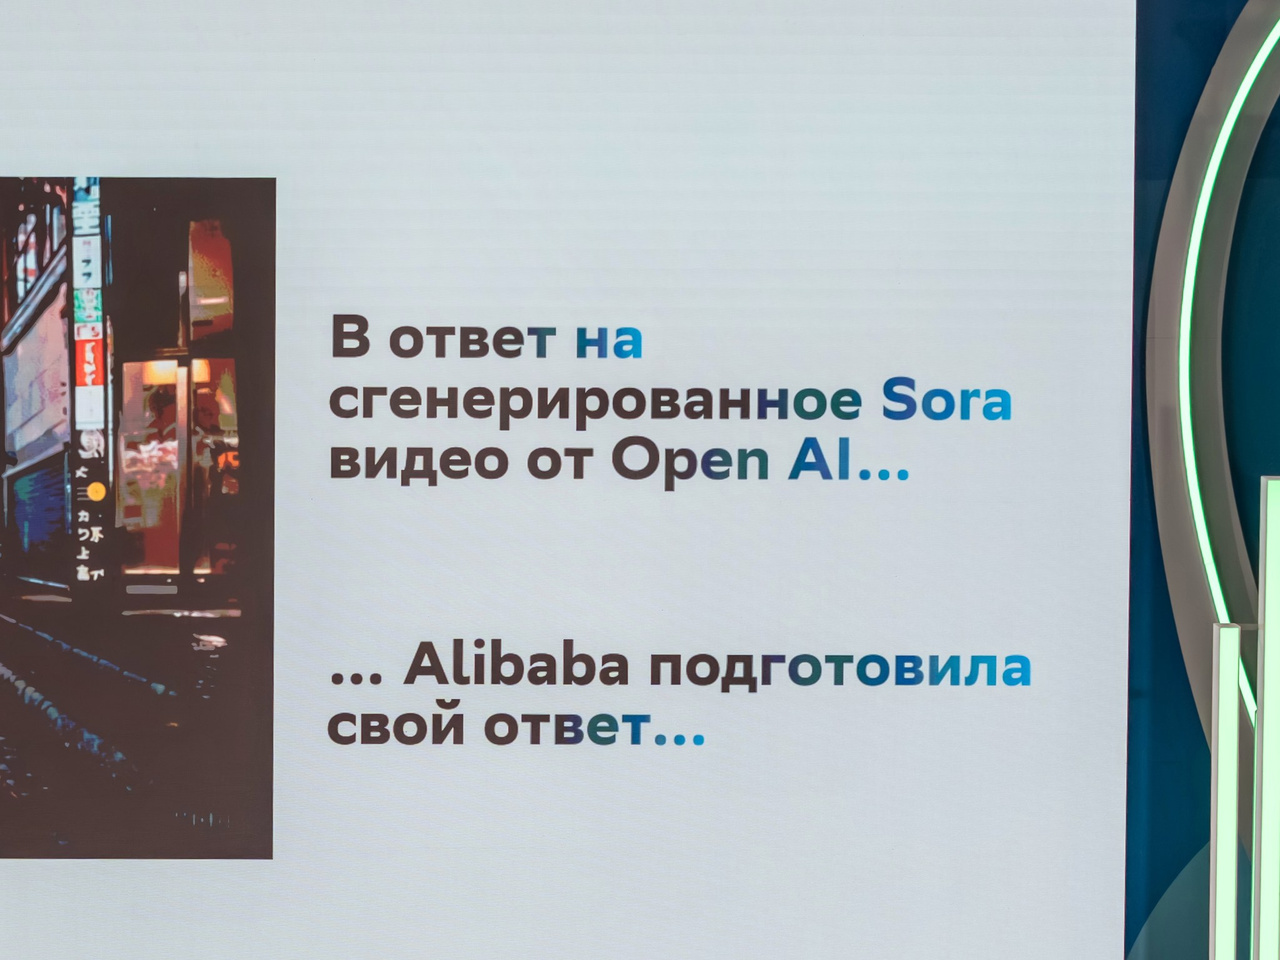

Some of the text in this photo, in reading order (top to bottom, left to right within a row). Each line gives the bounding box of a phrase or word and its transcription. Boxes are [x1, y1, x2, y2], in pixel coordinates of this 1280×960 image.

[331, 314, 644, 360] В ответ на
[329, 377, 1013, 431] сгенерированное Sora
[330, 446, 510, 487] видео
[527, 446, 595, 481] от
[612, 436, 770, 492] Open
[404, 639, 630, 687] Alibaba
[650, 653, 1033, 694] подготовила
[328, 698, 706, 747] свой ответ...
